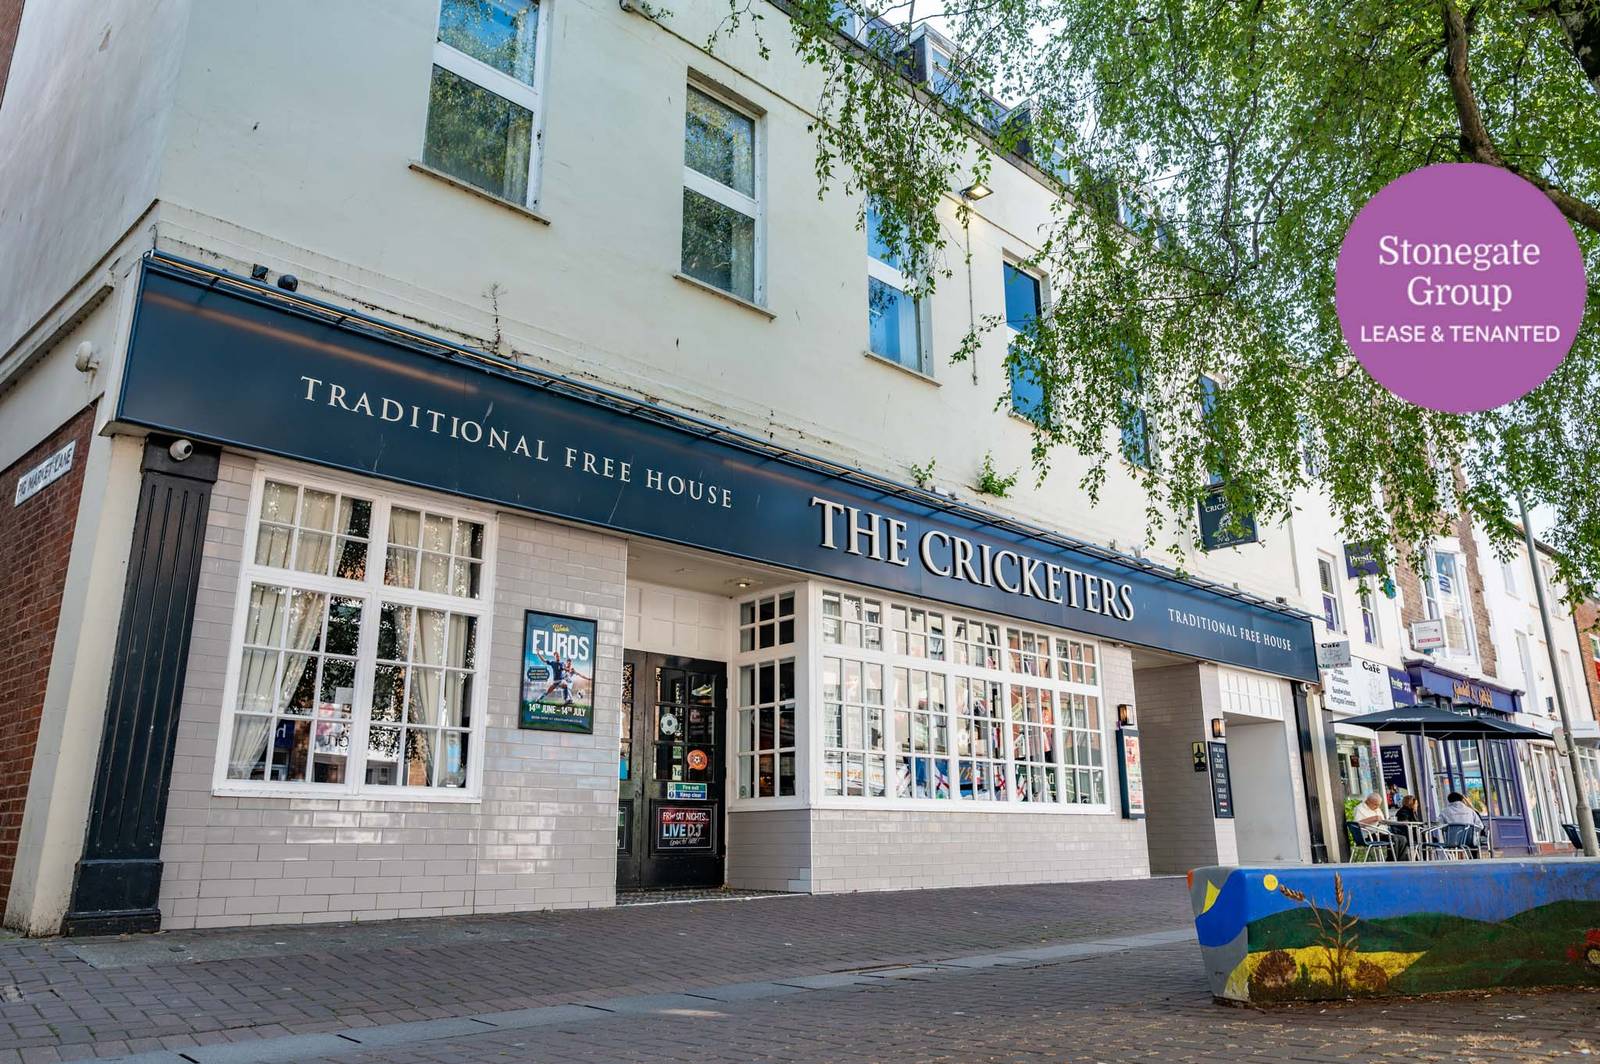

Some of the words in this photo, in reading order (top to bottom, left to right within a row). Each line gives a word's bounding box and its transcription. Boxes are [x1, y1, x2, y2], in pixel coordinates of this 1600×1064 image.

[301, 376, 549, 462] TRADITIONAL
[565, 447, 632, 483] FREE
[645, 469, 733, 509] HOUSE
[811, 497, 909, 567] THE
[919, 530, 1135, 622] CRICKETERS
[532, 629, 590, 661] EUROS
[1168, 608, 1237, 638] TRADITIONAL
[1240, 627, 1261, 644] FREE
[1264, 633, 1292, 652] HOUSE
[1362, 661, 1381, 674] Café
[529, 703, 540, 712] 14TH
[541, 704, 556, 714] JUNE
[561, 706, 572, 716] 14TH
[573, 707, 586, 717] JULY
[663, 823, 686, 837] LIVE
